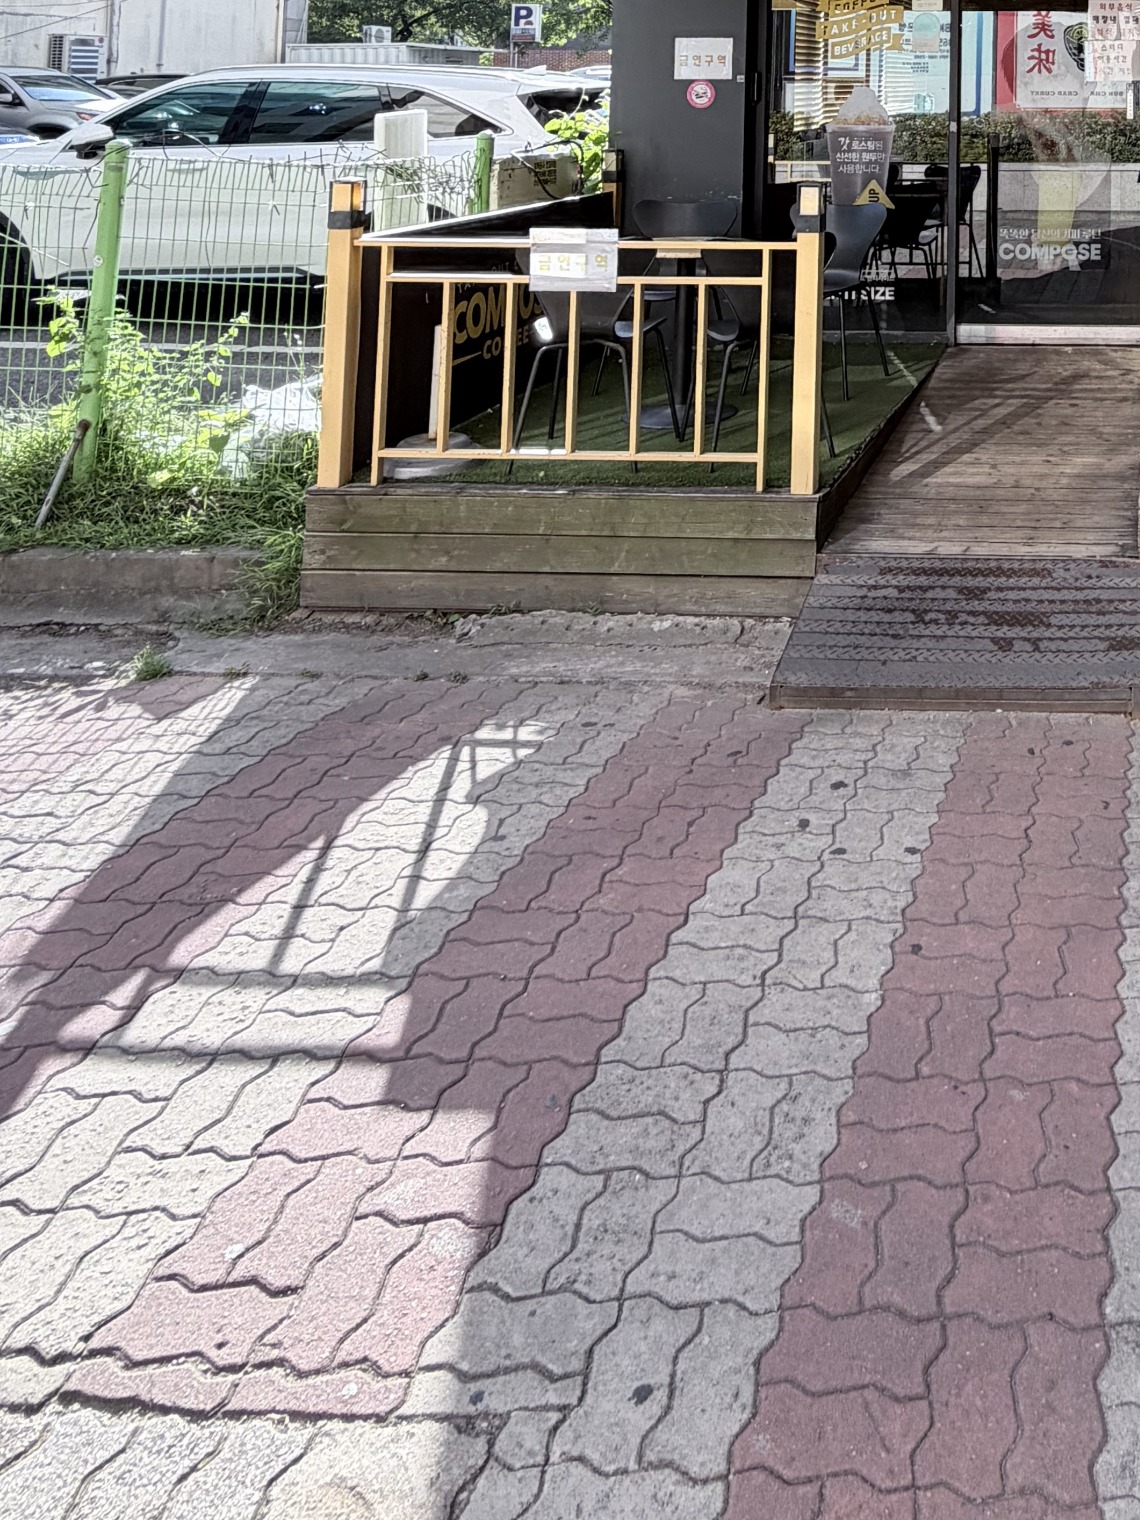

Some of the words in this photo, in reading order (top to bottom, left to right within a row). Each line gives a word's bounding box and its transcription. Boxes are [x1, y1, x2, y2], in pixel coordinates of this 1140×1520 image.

[514, 5, 534, 27] P
[821, 9, 897, 36] TAKE-OUT
[833, 30, 889, 56] BEVERAGE
[835, 151, 860, 162] 신선한
[868, 188, 880, 203] UP
[998, 242, 1102, 261] COMPOSE
